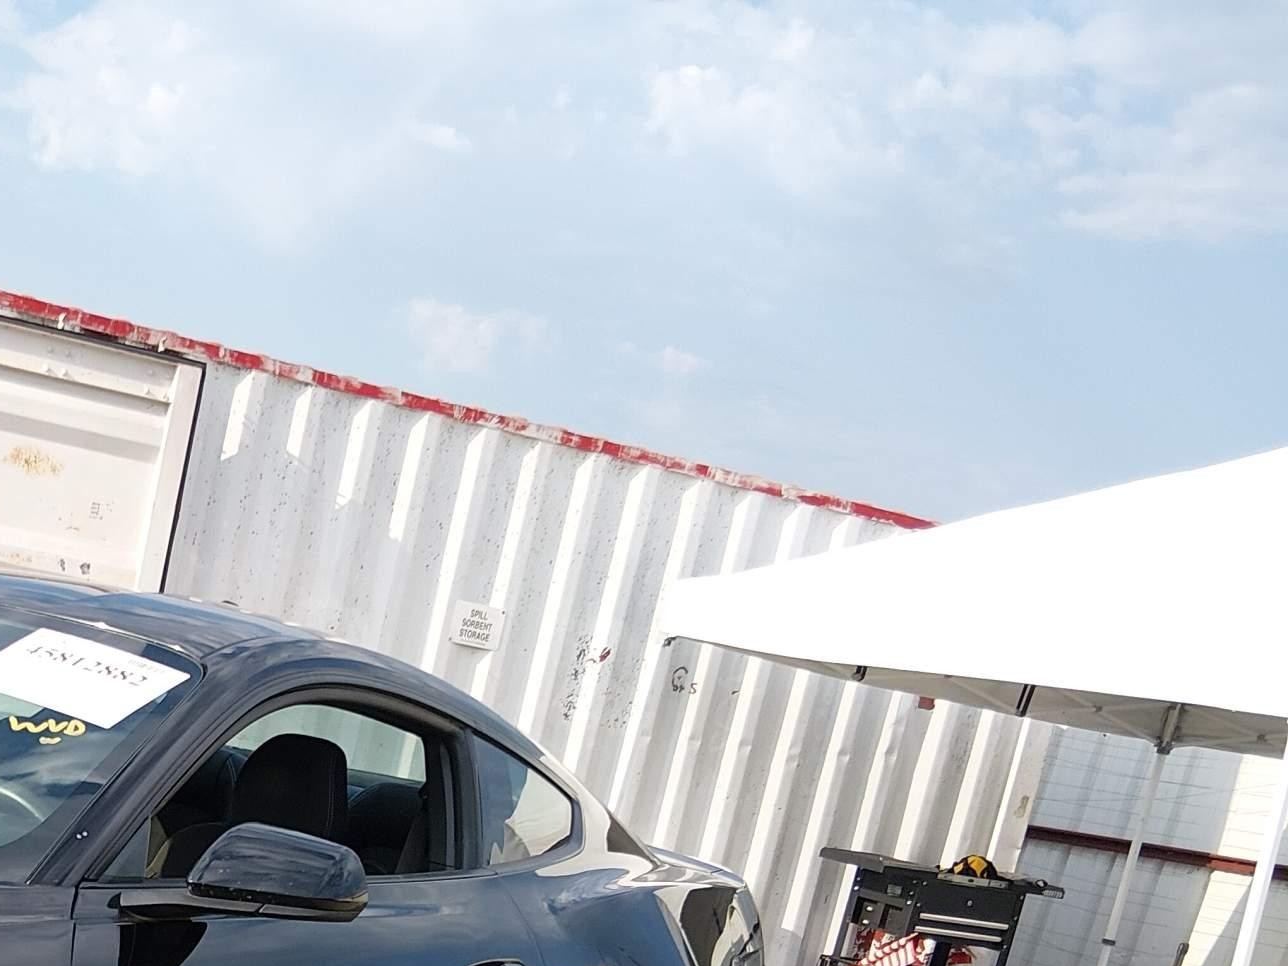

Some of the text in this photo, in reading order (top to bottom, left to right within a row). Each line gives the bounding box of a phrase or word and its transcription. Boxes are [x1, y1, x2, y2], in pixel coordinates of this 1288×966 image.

[471, 609, 488, 621] SPILL
[462, 618, 493, 632] SORBENT
[459, 628, 490, 642] STORAGE
